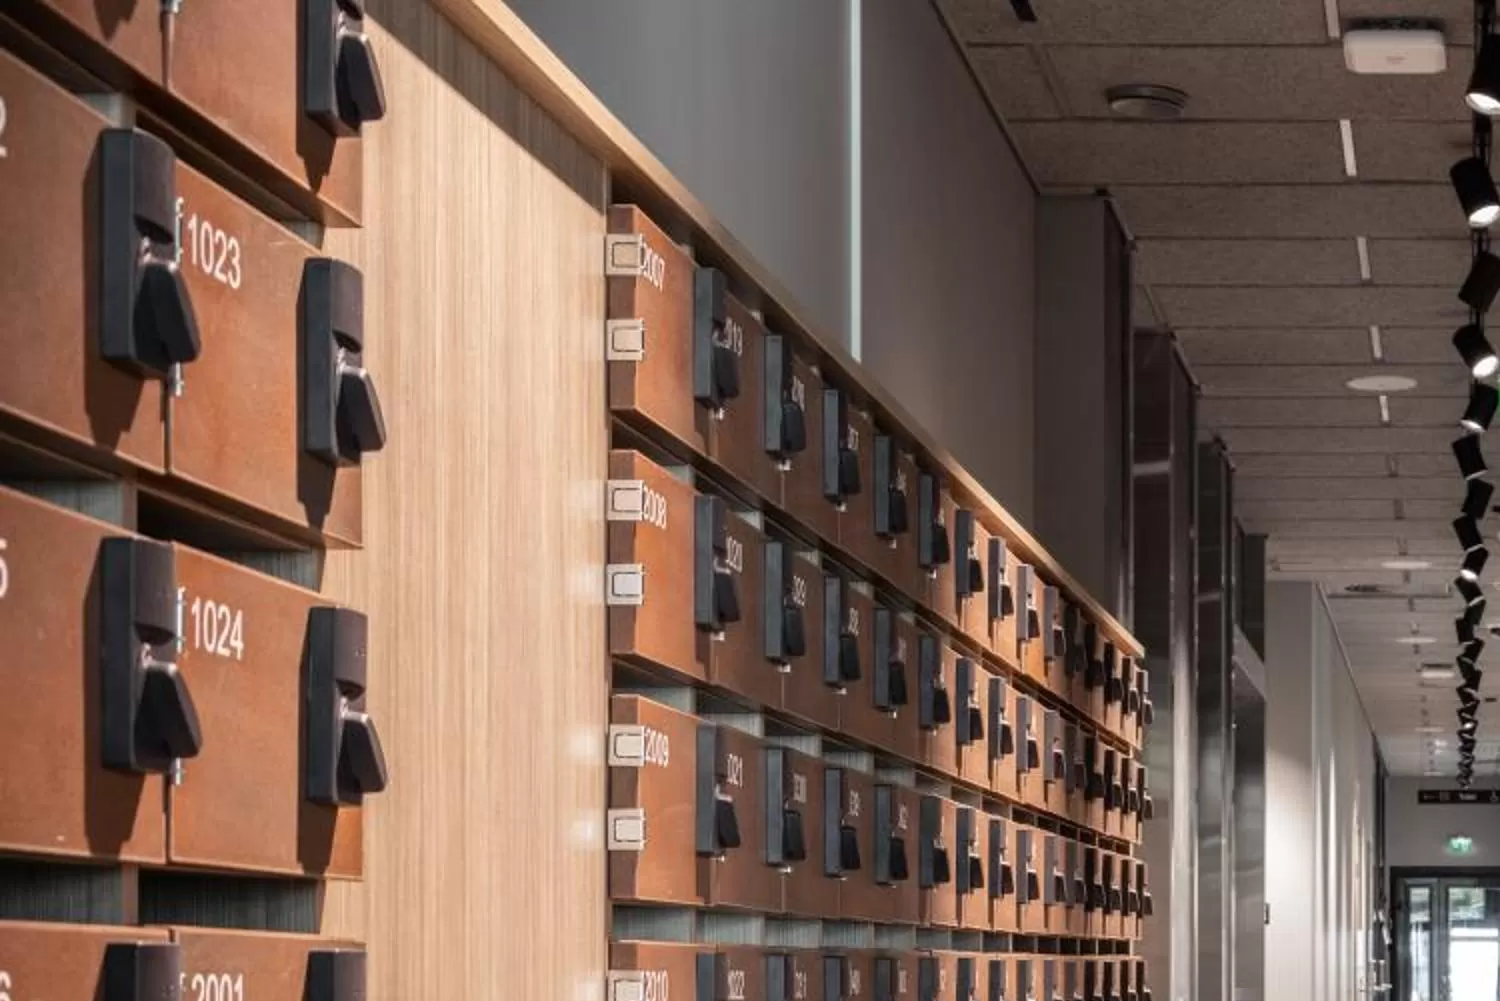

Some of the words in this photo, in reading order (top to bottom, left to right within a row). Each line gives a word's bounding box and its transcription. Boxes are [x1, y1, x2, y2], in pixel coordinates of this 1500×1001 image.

[187, 212, 241, 289] 1023
[642, 242, 665, 291] 2007
[190, 596, 243, 661] 1024
